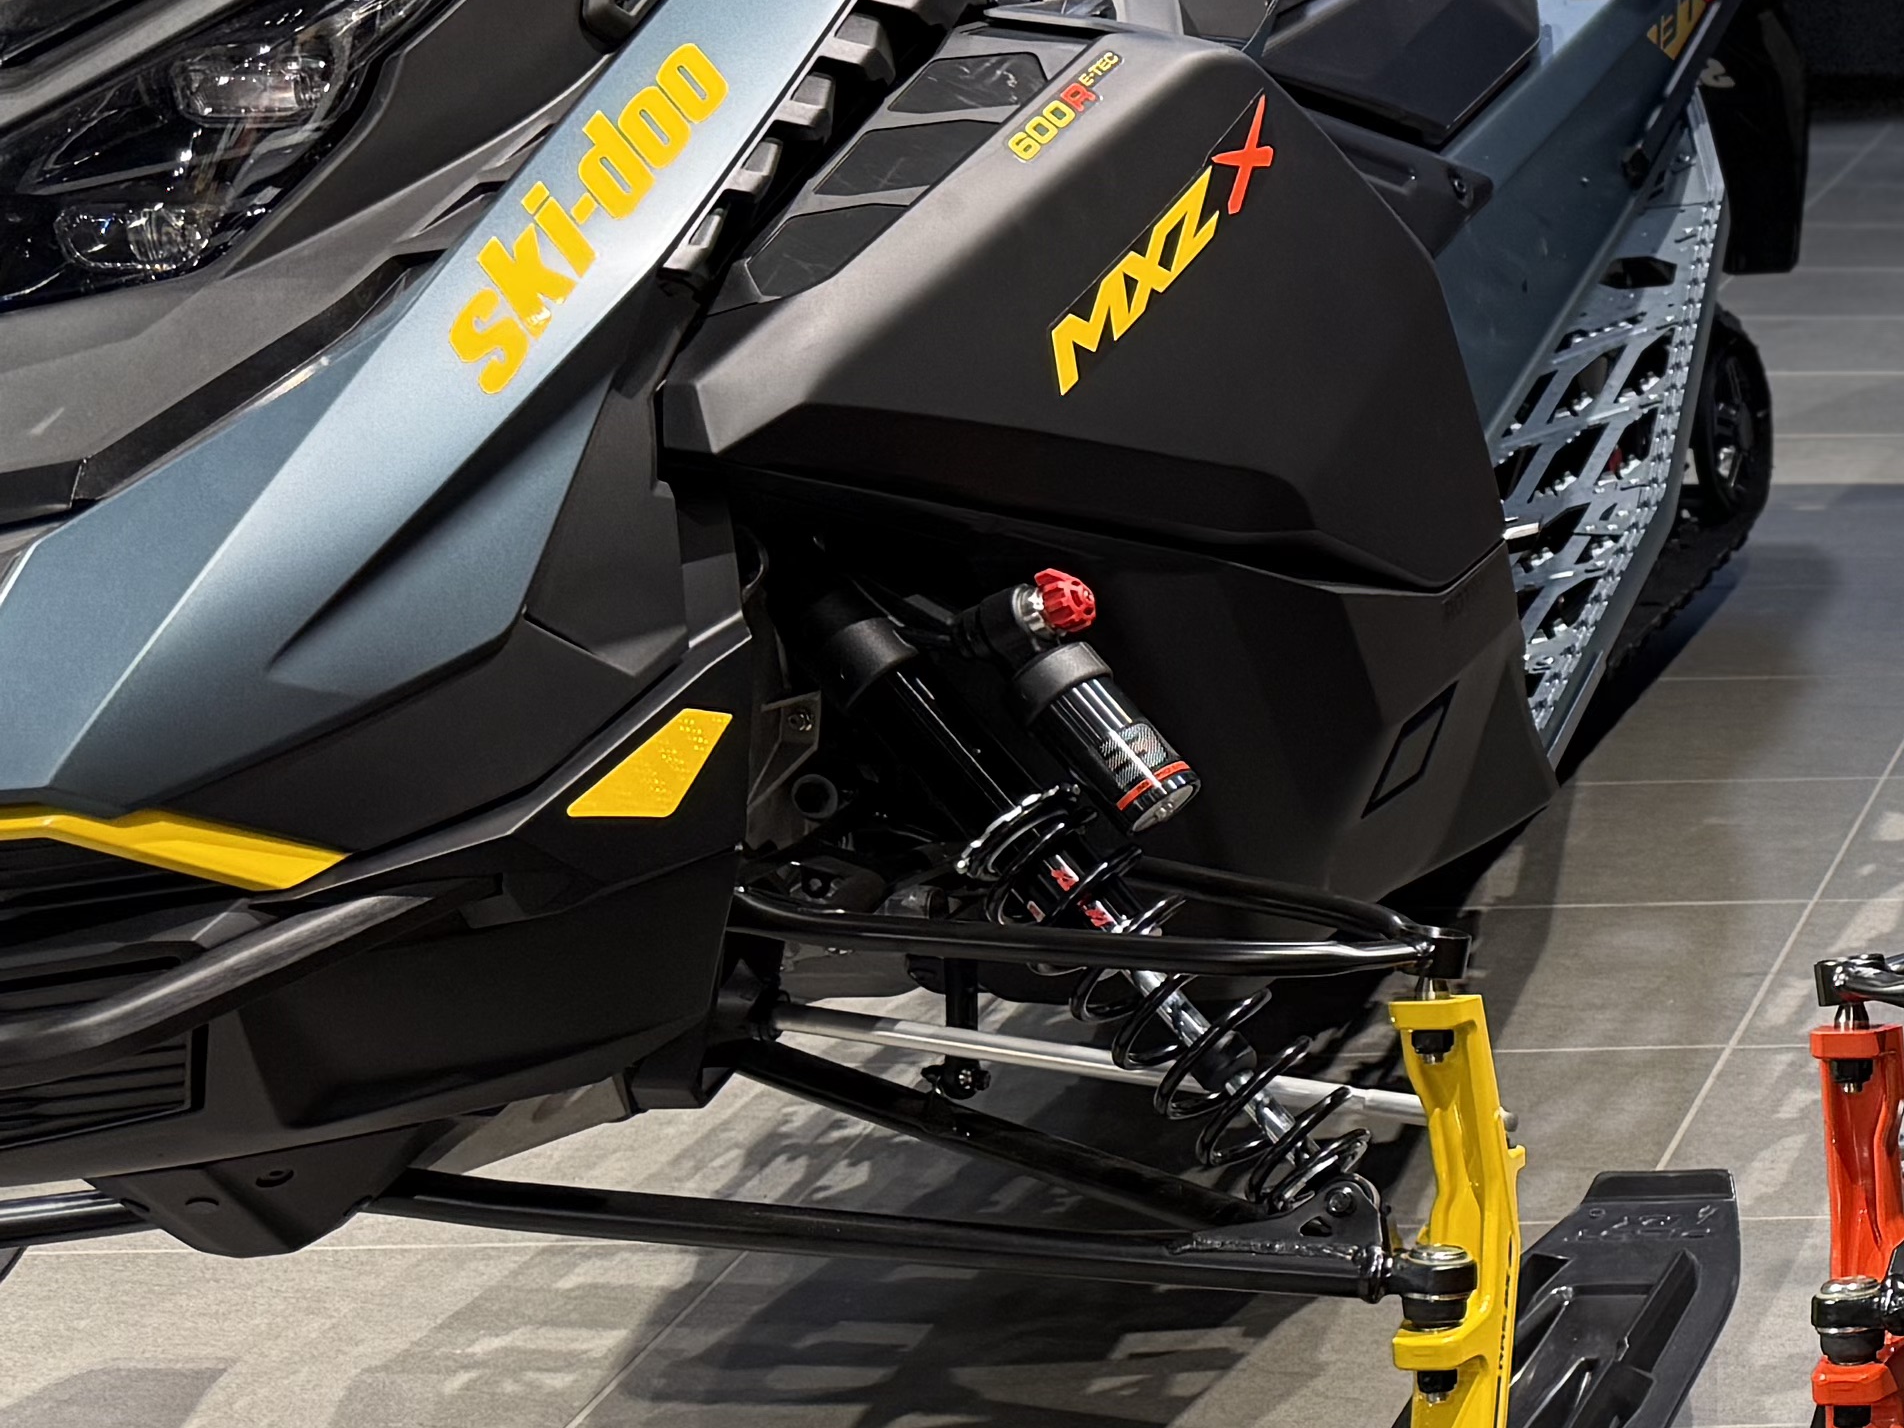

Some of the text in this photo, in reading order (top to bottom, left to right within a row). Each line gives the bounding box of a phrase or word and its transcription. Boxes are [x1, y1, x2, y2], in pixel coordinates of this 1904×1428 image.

[449, 42, 730, 395] ski-doo
[1008, 52, 1119, 160] 600R E-TEC
